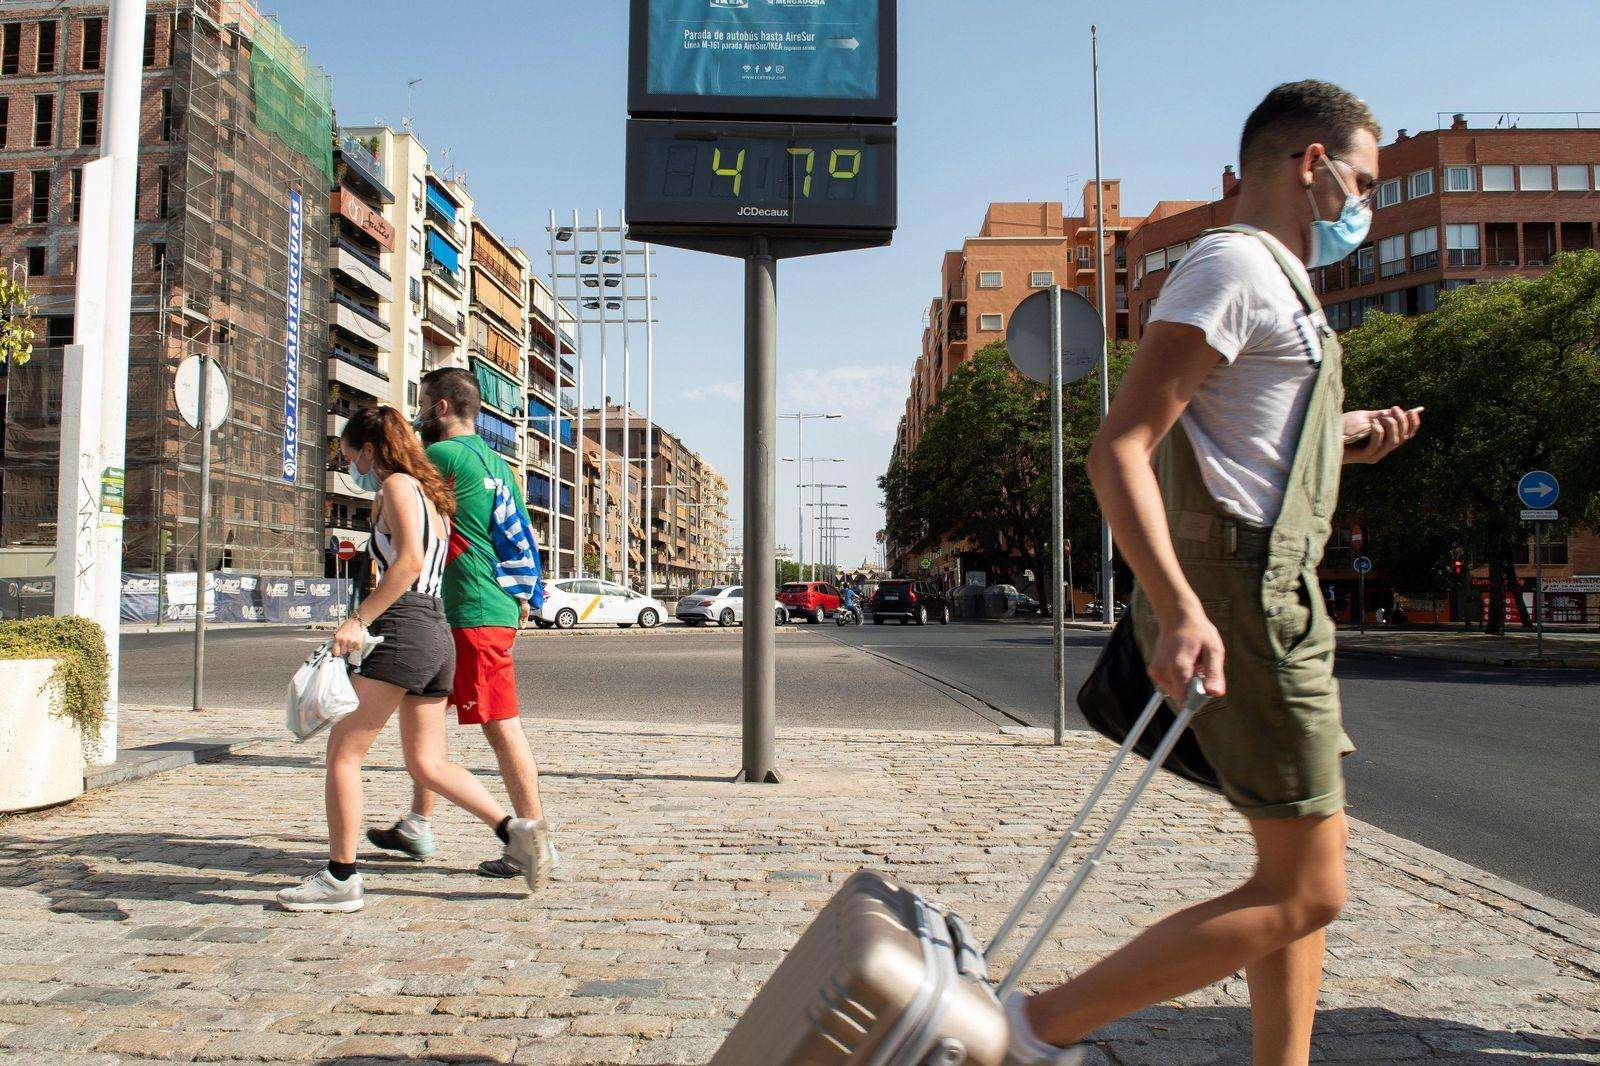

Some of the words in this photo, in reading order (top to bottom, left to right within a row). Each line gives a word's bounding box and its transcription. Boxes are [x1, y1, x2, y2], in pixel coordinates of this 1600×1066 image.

[684, 30, 712, 40] Parada
[714, 30, 724, 40] de
[726, 31, 759, 41] autobús
[760, 31, 783, 41] hasta
[785, 32, 816, 42] AireSur
[721, 42, 743, 51] parada
[743, 42, 783, 51] AireSur/IKEA
[737, 207, 789, 217] JCDecaux
[287, 199, 300, 408] INFRAESTRUCTURAS
[286, 415, 296, 458] ACP
